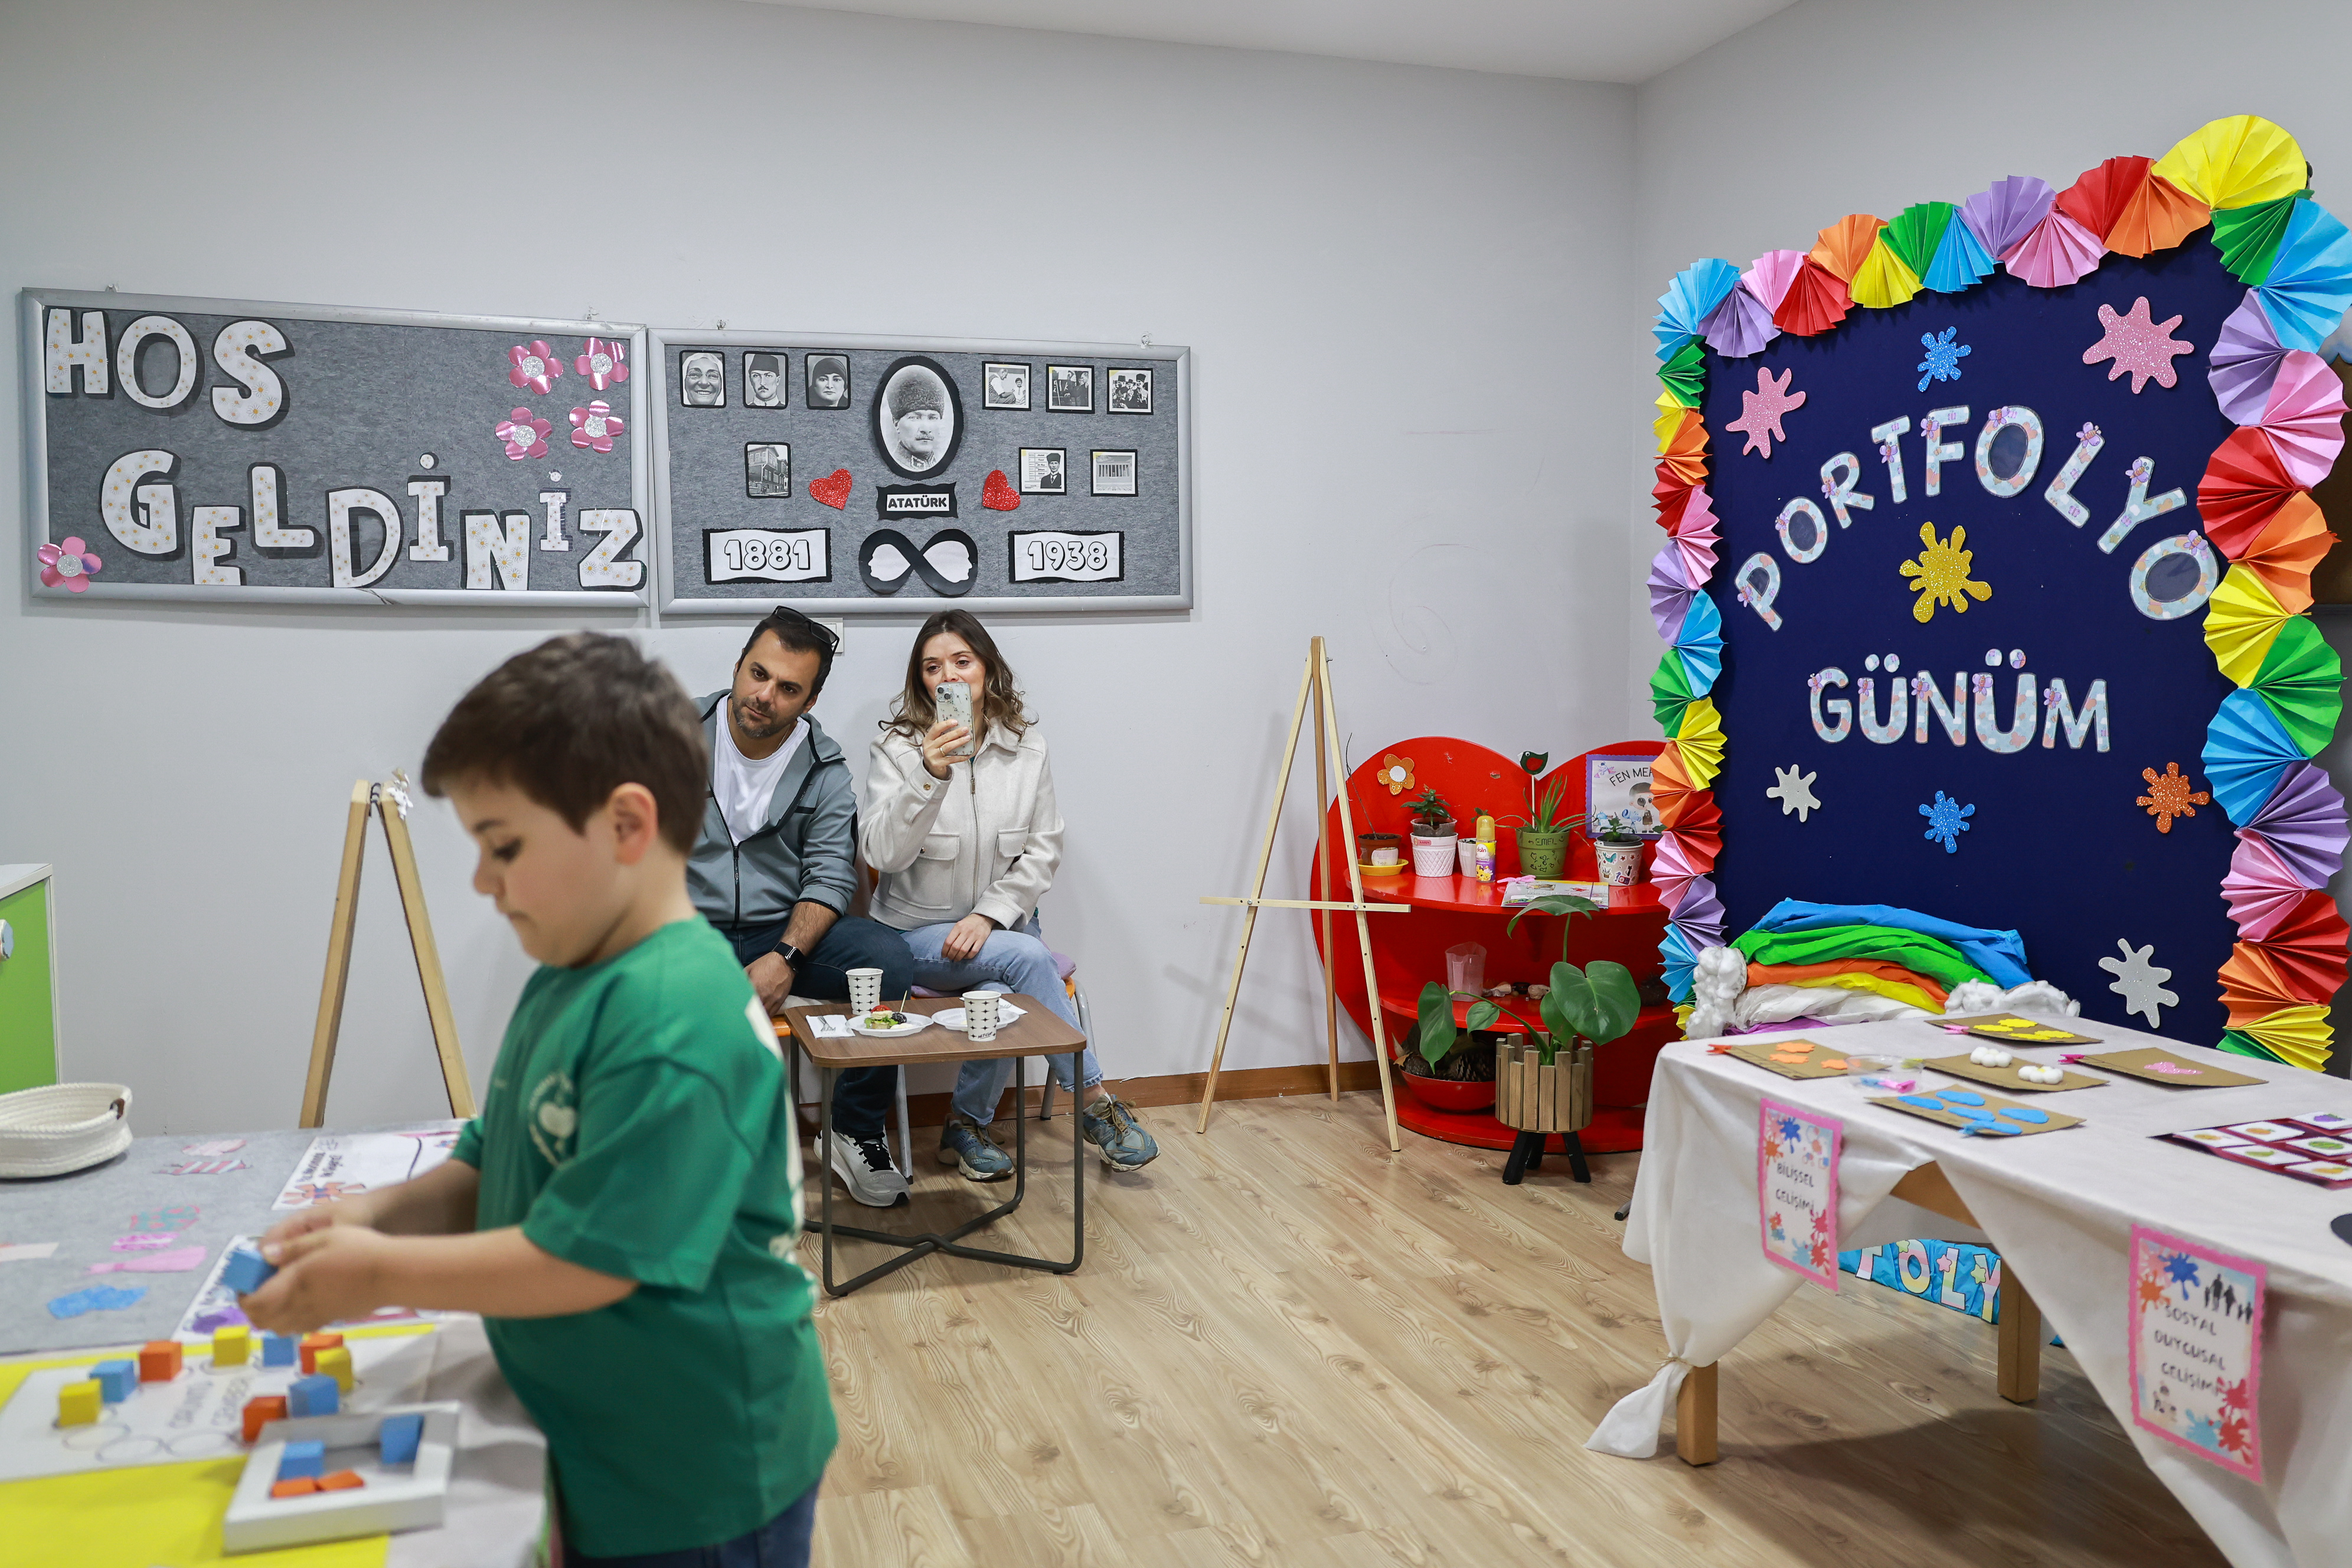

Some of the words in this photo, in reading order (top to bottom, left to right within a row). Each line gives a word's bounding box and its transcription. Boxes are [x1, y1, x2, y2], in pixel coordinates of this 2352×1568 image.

[46, 308, 290, 426] HOS
[888, 494, 947, 508] ATATÜRK
[100, 449, 643, 591] GELDİNİZ
[1734, 405, 2220, 632] PORTFOLYO
[724, 539, 811, 571] 1881
[1027, 540, 1108, 571] 1938
[1807, 648, 2111, 754] GÜNÜM
[1609, 770, 1631, 786] FEN
[2165, 1304, 2217, 1336] SOSYAL
